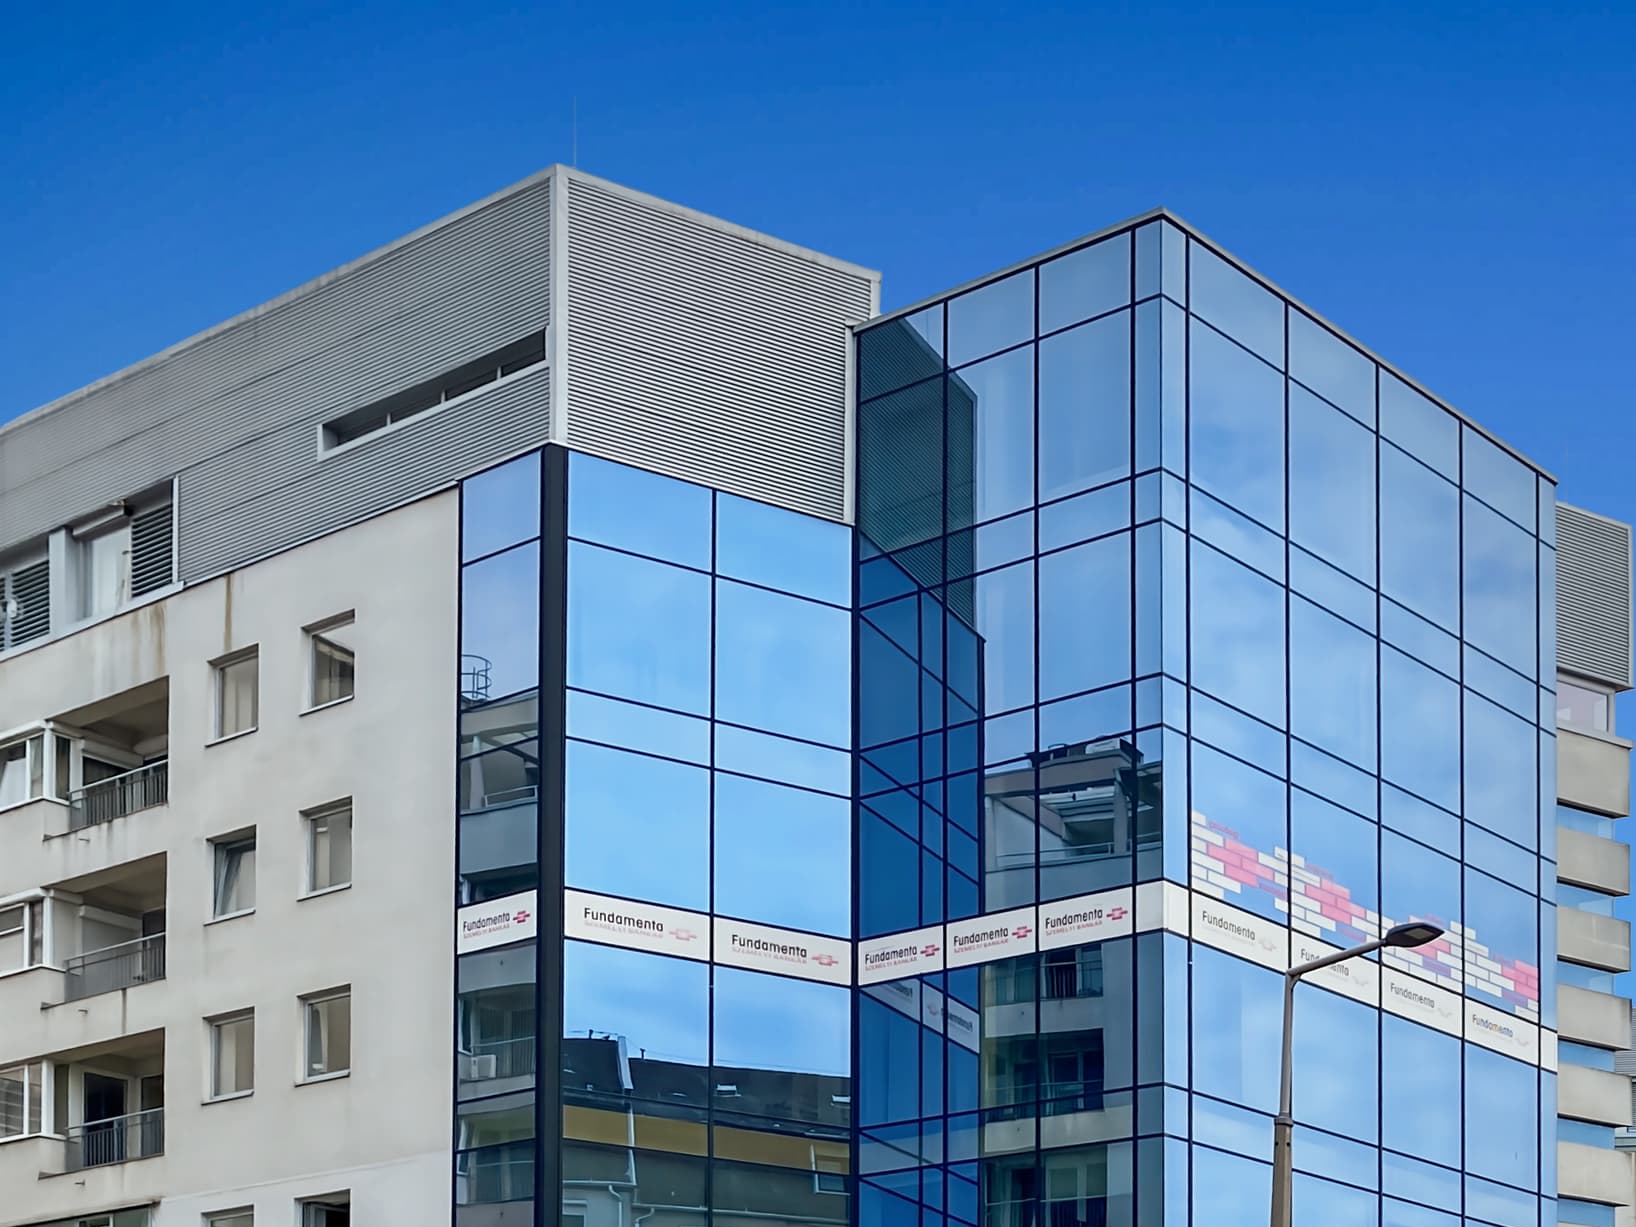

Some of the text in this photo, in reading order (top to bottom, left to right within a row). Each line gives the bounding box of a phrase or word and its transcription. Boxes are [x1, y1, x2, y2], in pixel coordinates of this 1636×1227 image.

[463, 912, 510, 932] Fundamenta
[585, 907, 664, 932] Fundamenta
[1045, 909, 1103, 928] Fundamenta
[1202, 910, 1256, 941] Fundamenta
[732, 934, 808, 958] Fundamenta
[953, 927, 1009, 947] Fundamenta
[864, 946, 918, 964] Fundamenta
[1390, 982, 1435, 1008] Fundamenta
